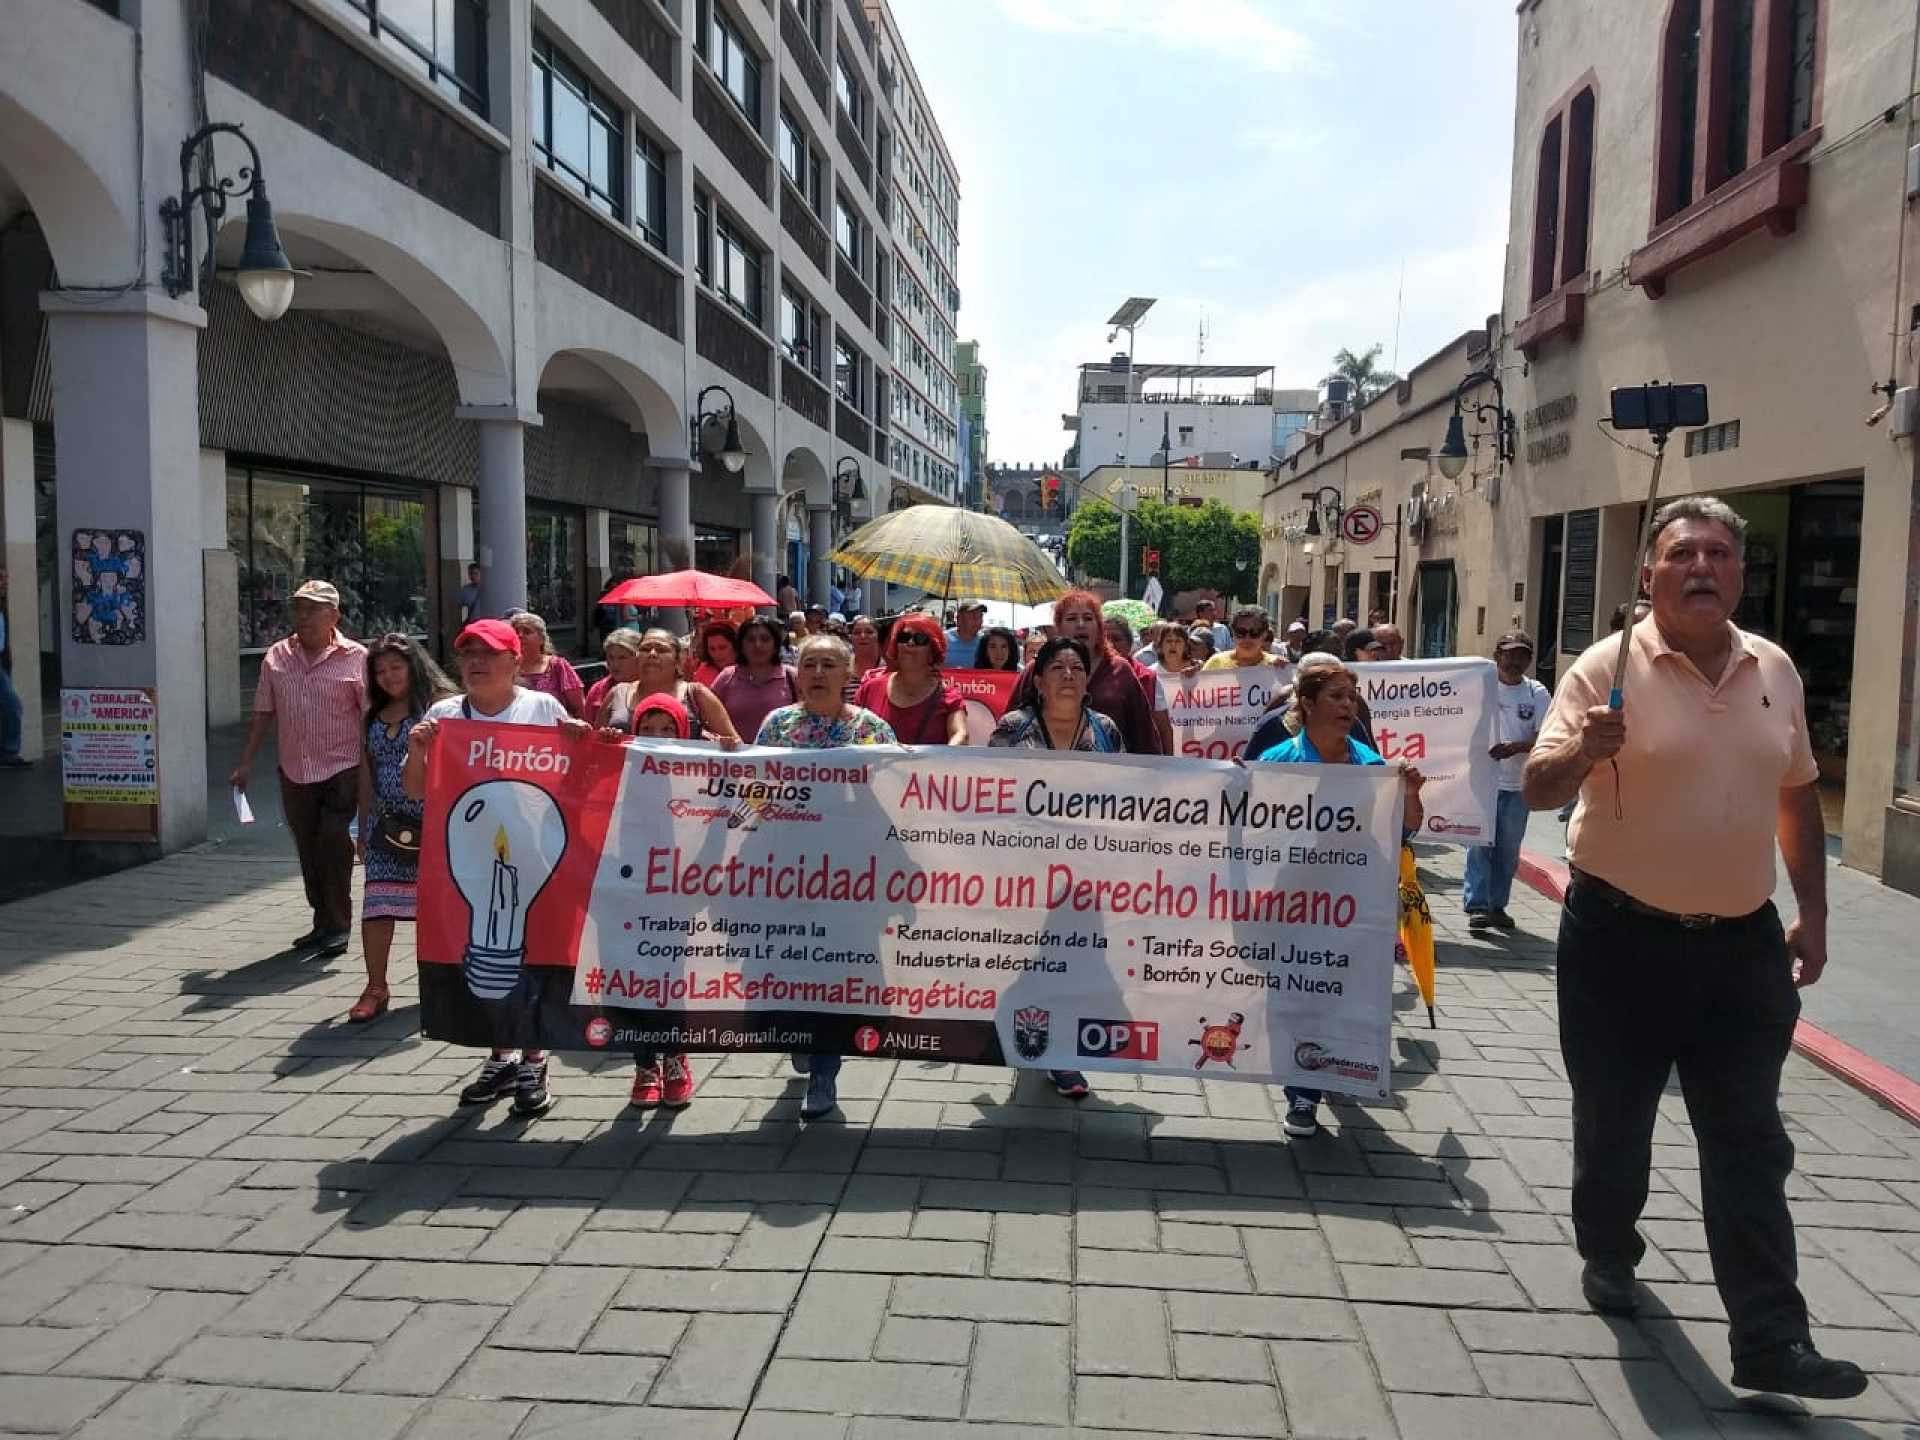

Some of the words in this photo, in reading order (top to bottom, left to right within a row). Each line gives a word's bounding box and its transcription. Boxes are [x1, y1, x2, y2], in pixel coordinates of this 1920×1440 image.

[1128, 482, 1190, 496] Domio's
[1172, 686, 1243, 709] ANUEE
[1367, 676, 1458, 700] Morelos.
[468, 737, 570, 774] Plantón
[641, 755, 757, 779] Asamblea
[765, 761, 868, 784] Nacional
[707, 778, 811, 801] Usuarios
[900, 773, 1017, 813] ANUEE
[1025, 779, 1209, 825] Cuernavaca
[1220, 790, 1361, 833] Morelos.
[886, 825, 975, 847] Asamblea
[982, 829, 1060, 850] Nacional
[1066, 833, 1087, 851] de
[1094, 834, 1173, 855] Usuarios
[1178, 838, 1201, 858] de
[1209, 842, 1281, 865] Energía
[1289, 847, 1367, 866] Eléctrica
[646, 846, 877, 902] Electricidad
[886, 869, 985, 907] como
[995, 874, 1035, 908] un
[1047, 863, 1197, 919] Derecho
[1209, 874, 1356, 927] humano
[638, 916, 707, 937] Trabajo
[711, 918, 761, 937] digno
[765, 922, 806, 939] para
[811, 921, 826, 938] la
[897, 924, 1061, 948] Renacionalización
[1065, 931, 1088, 948] de
[1092, 931, 1108, 949] la
[638, 941, 750, 961] Cooperativa
[755, 945, 774, 959] Lf
[780, 945, 808, 961] del
[812, 948, 879, 964] Centro.
[896, 951, 981, 969] Industria
[986, 953, 1067, 973] eléctrica
[1143, 935, 1205, 958] Tarifa
[1210, 940, 1276, 961] Social
[1281, 943, 1349, 968] Justa
[585, 968, 996, 1014] #AbajoLaReformaEnergética
[1143, 964, 1200, 983] Borrón
[1205, 970, 1215, 989] y
[1220, 967, 1281, 991] Cuenta
[1287, 973, 1343, 996] Nueva
[614, 1027, 812, 1047] anueeoficial1@gmail.com
[883, 1031, 941, 1051] ANUEE
[1081, 1023, 1155, 1053] OPT
